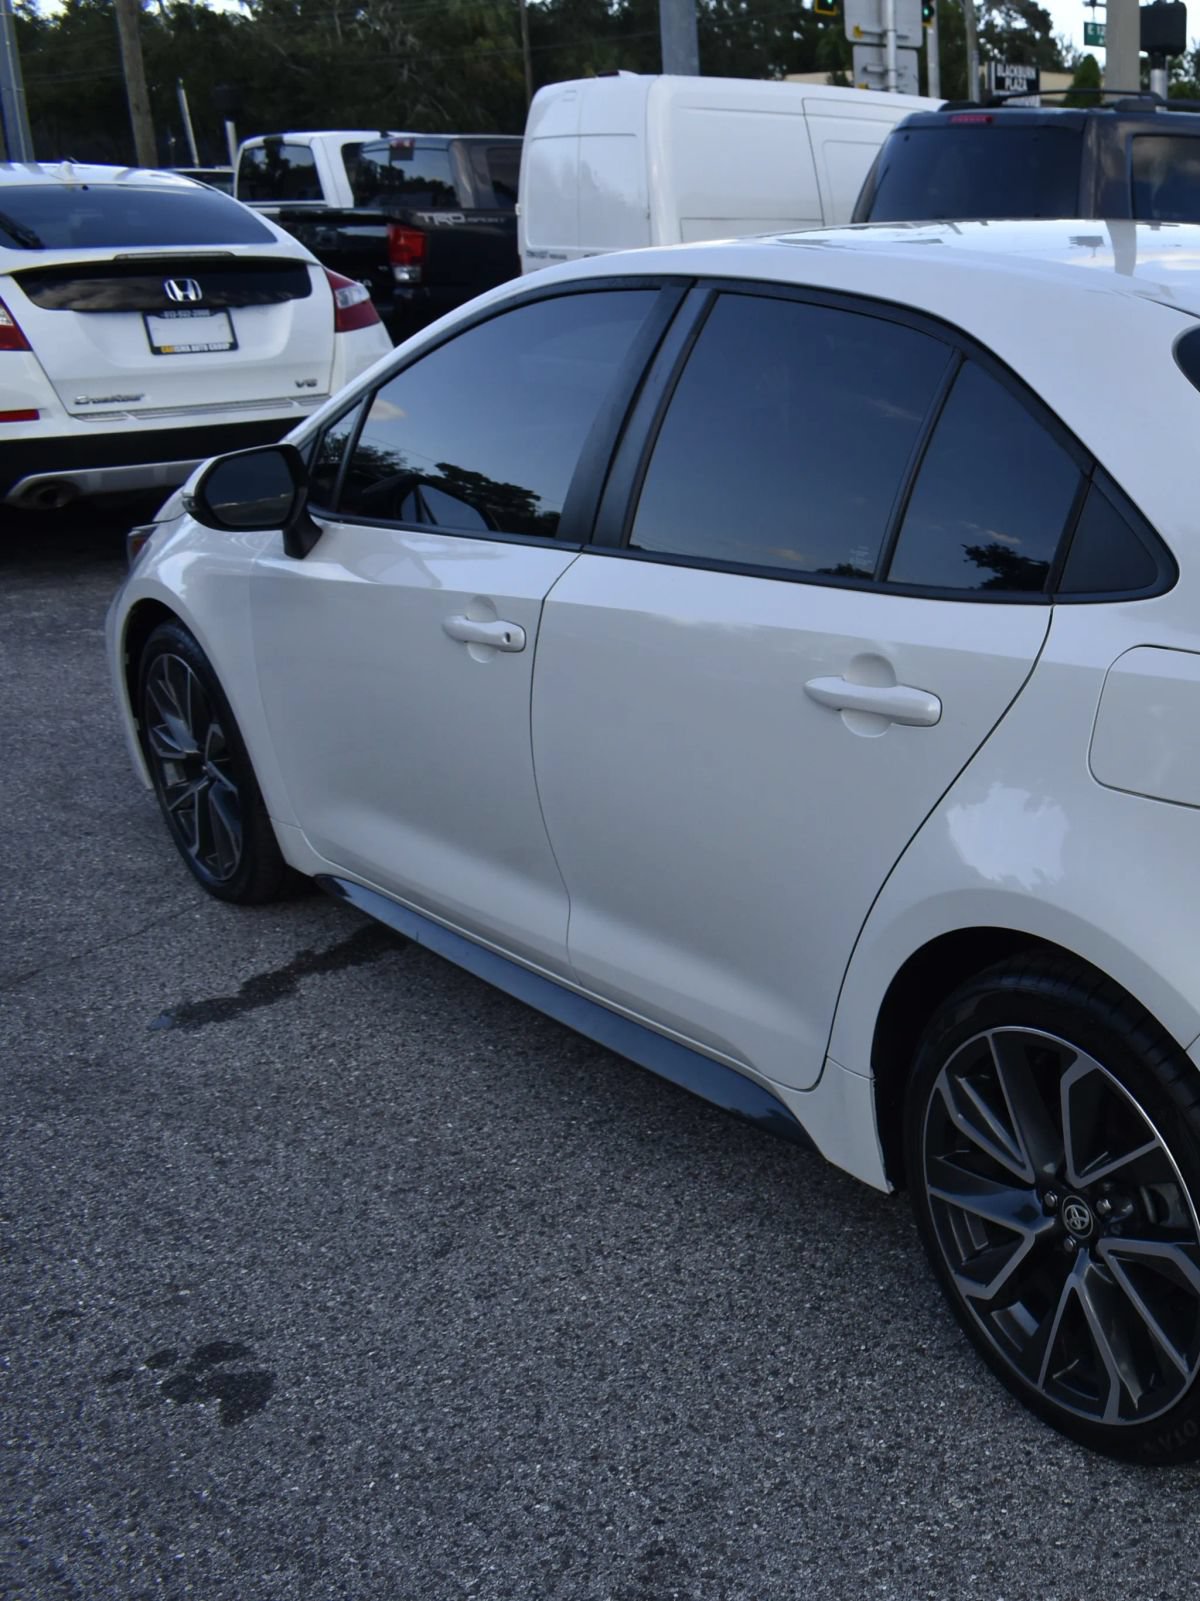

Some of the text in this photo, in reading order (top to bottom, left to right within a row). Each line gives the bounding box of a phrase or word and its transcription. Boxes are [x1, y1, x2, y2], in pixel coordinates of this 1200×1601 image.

[996, 63, 1036, 79] BLACKBURN
[1004, 76, 1028, 91] PLAZA
[417, 212, 467, 226] TRD
